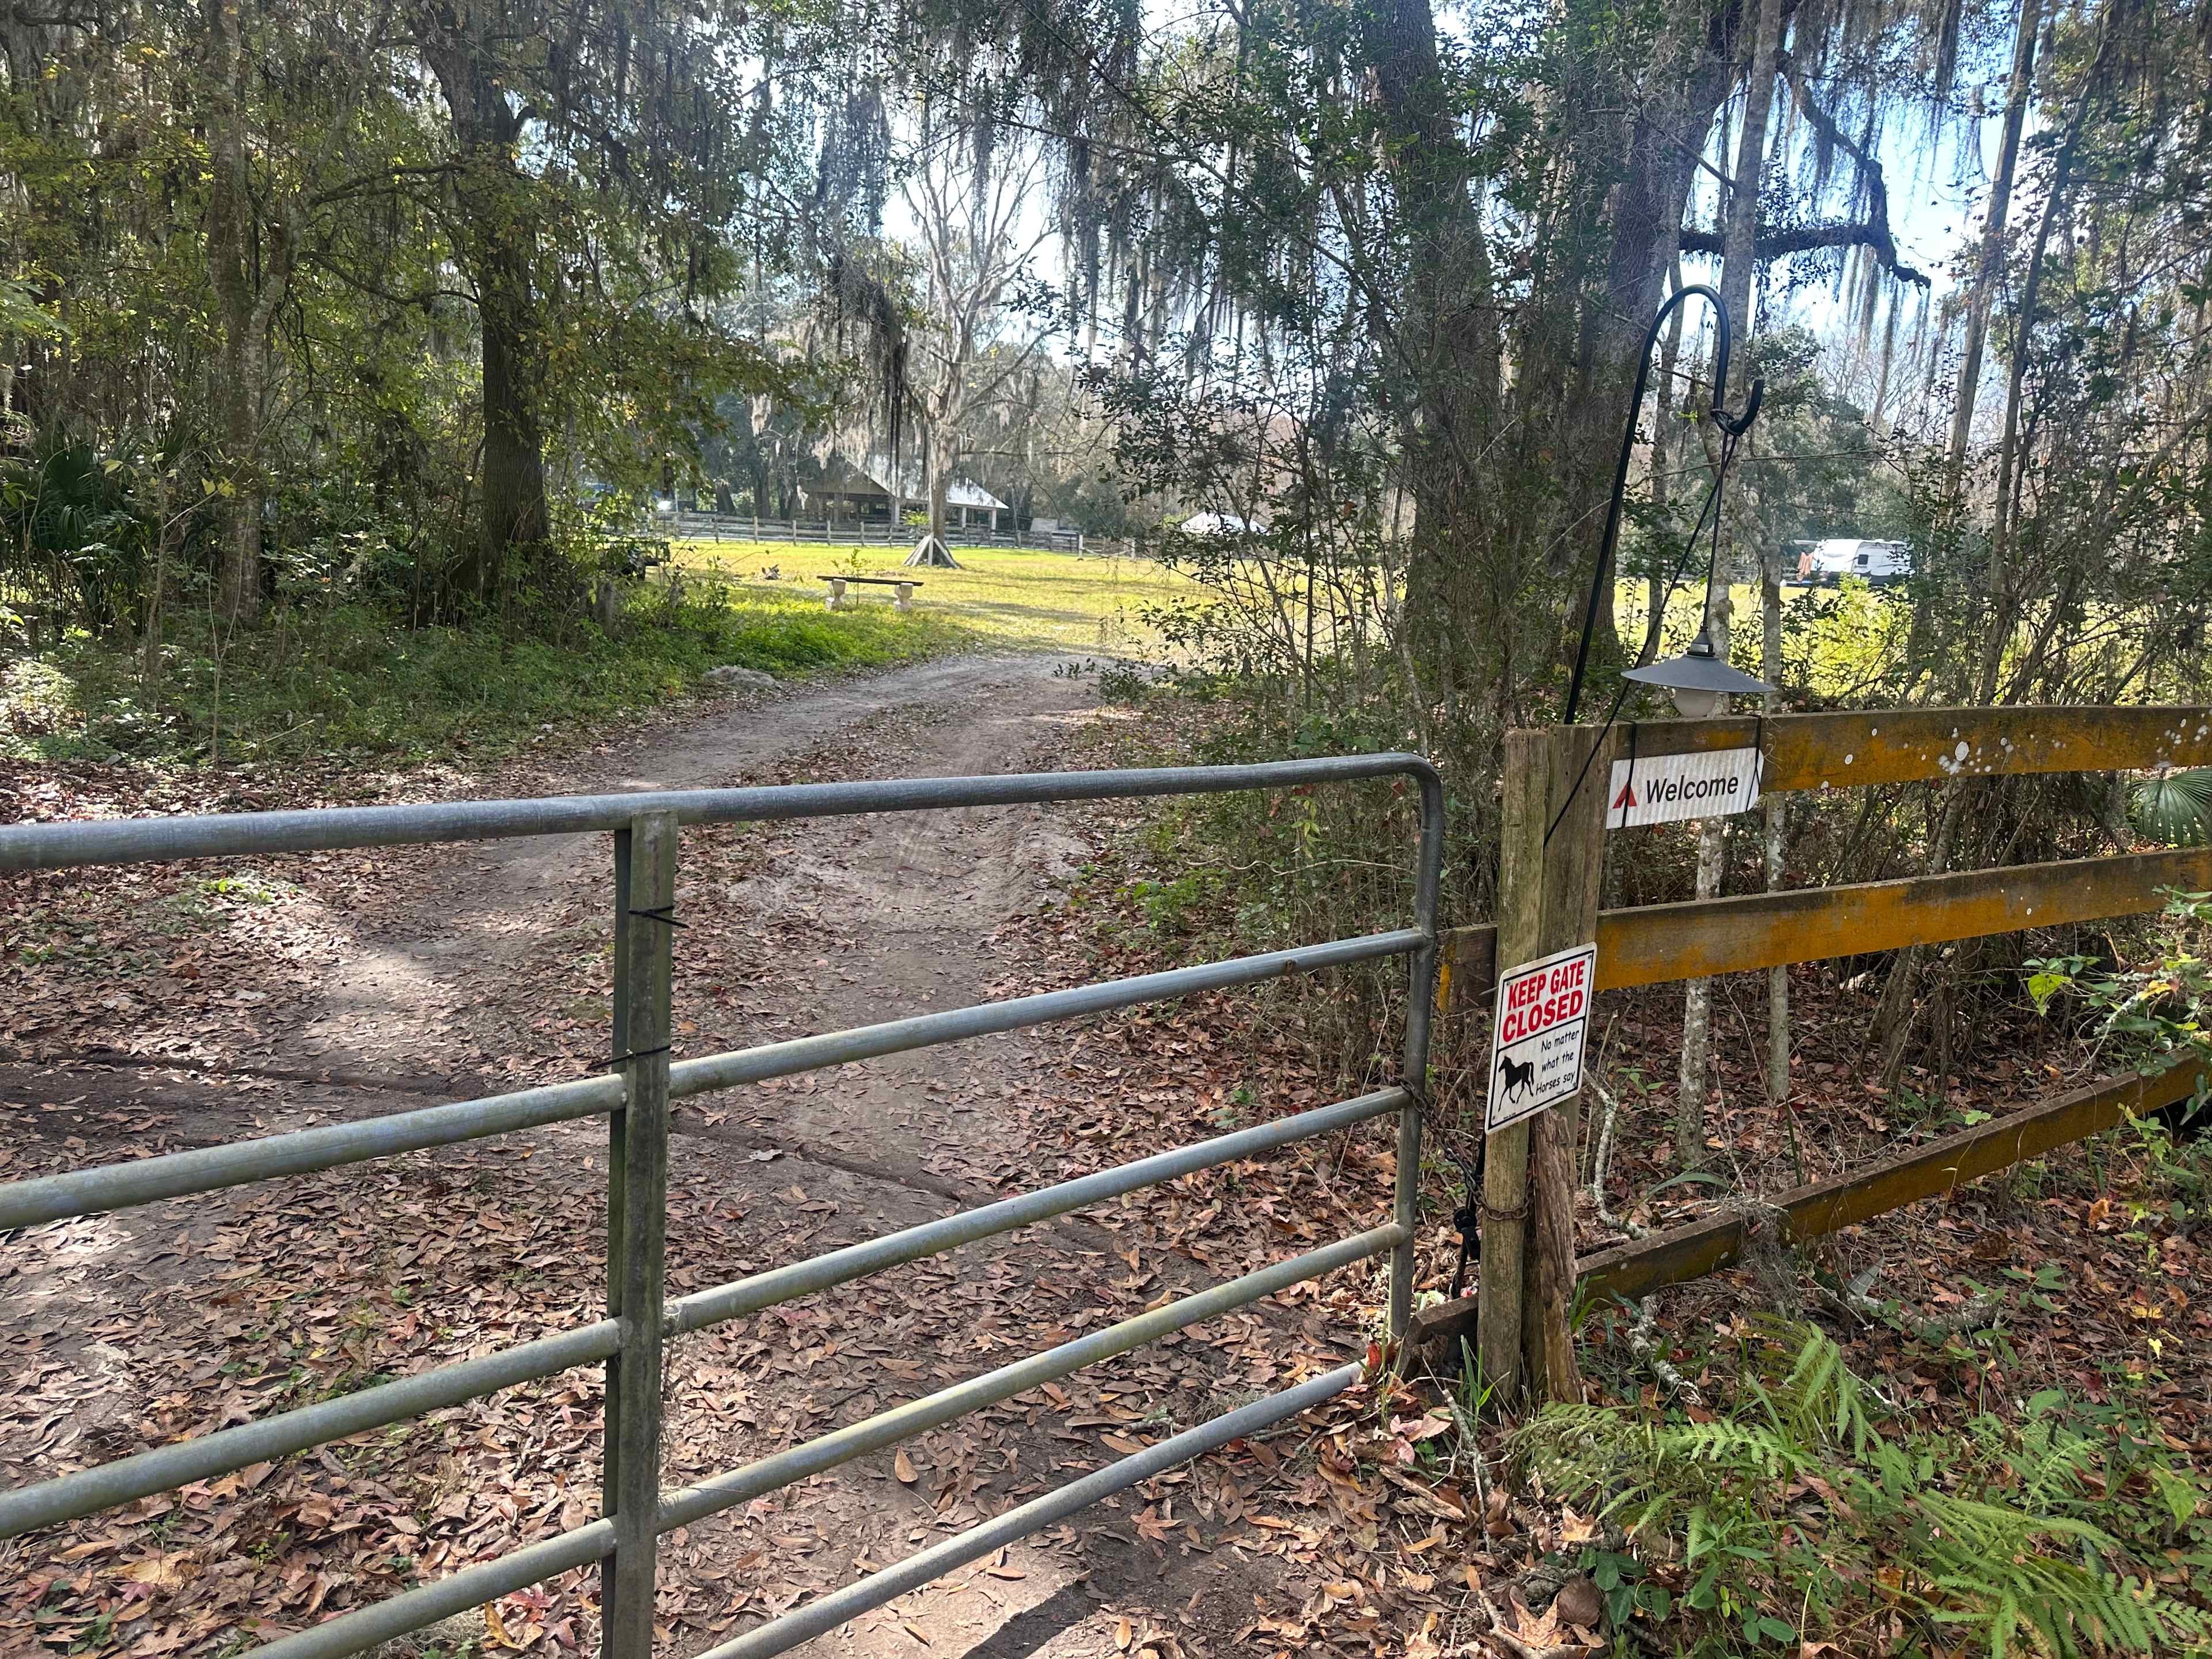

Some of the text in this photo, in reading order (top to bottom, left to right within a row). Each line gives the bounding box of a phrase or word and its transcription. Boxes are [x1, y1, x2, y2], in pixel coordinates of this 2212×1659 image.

[1647, 775, 1738, 804] Welcome
[1508, 960, 1585, 1012] KEEP GATE
[1502, 990, 1584, 1043] CLOSED
[1541, 1030, 1580, 1053] No matter
[1541, 1051, 1574, 1073] what the
[1536, 1071, 1575, 1095] Horses say
